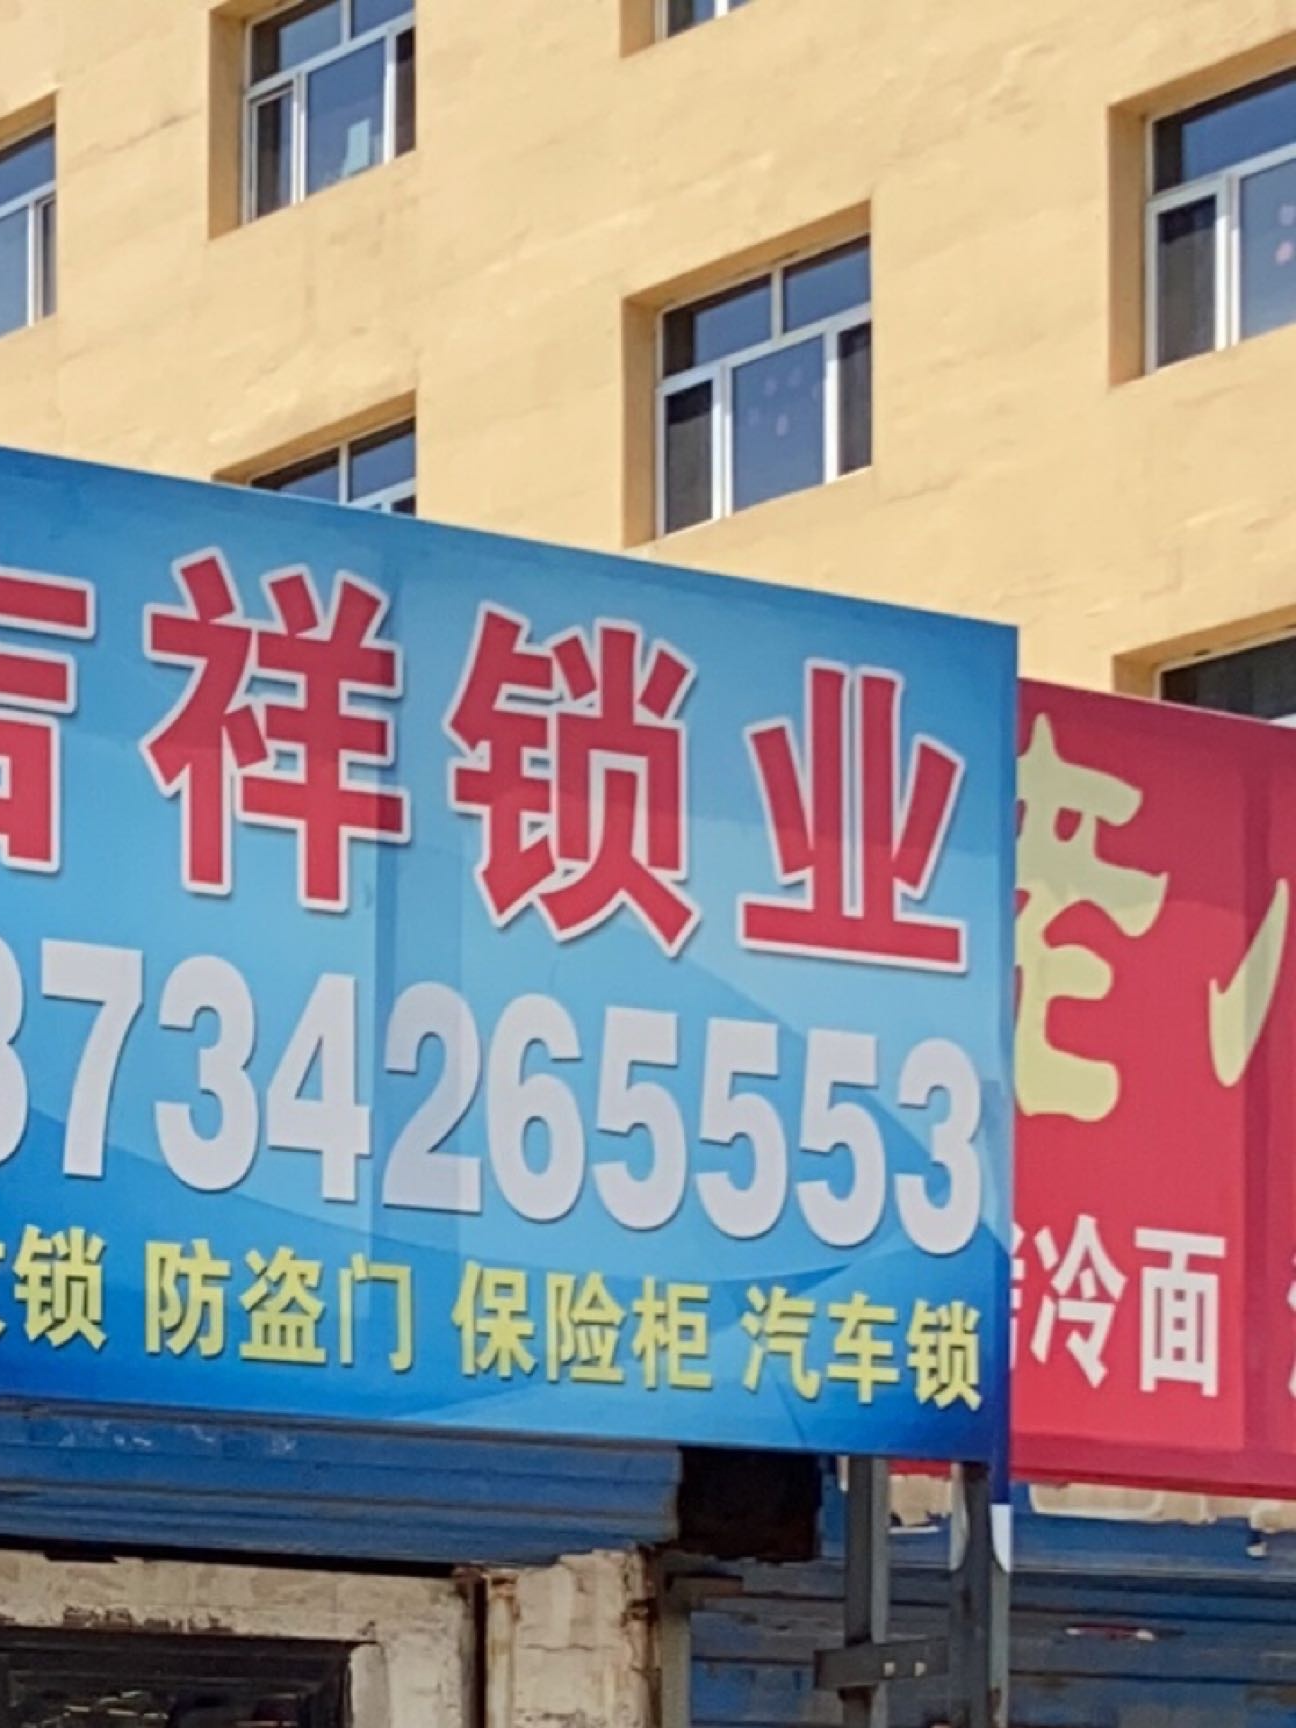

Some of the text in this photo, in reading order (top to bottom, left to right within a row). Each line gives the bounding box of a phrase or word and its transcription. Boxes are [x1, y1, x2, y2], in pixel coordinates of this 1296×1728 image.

[144, 1240, 414, 1371] 防盗门
[452, 1261, 710, 1391] 保险柜
[742, 1285, 981, 1411] 汽车锁
[1011, 1213, 1227, 1397] 冷面
